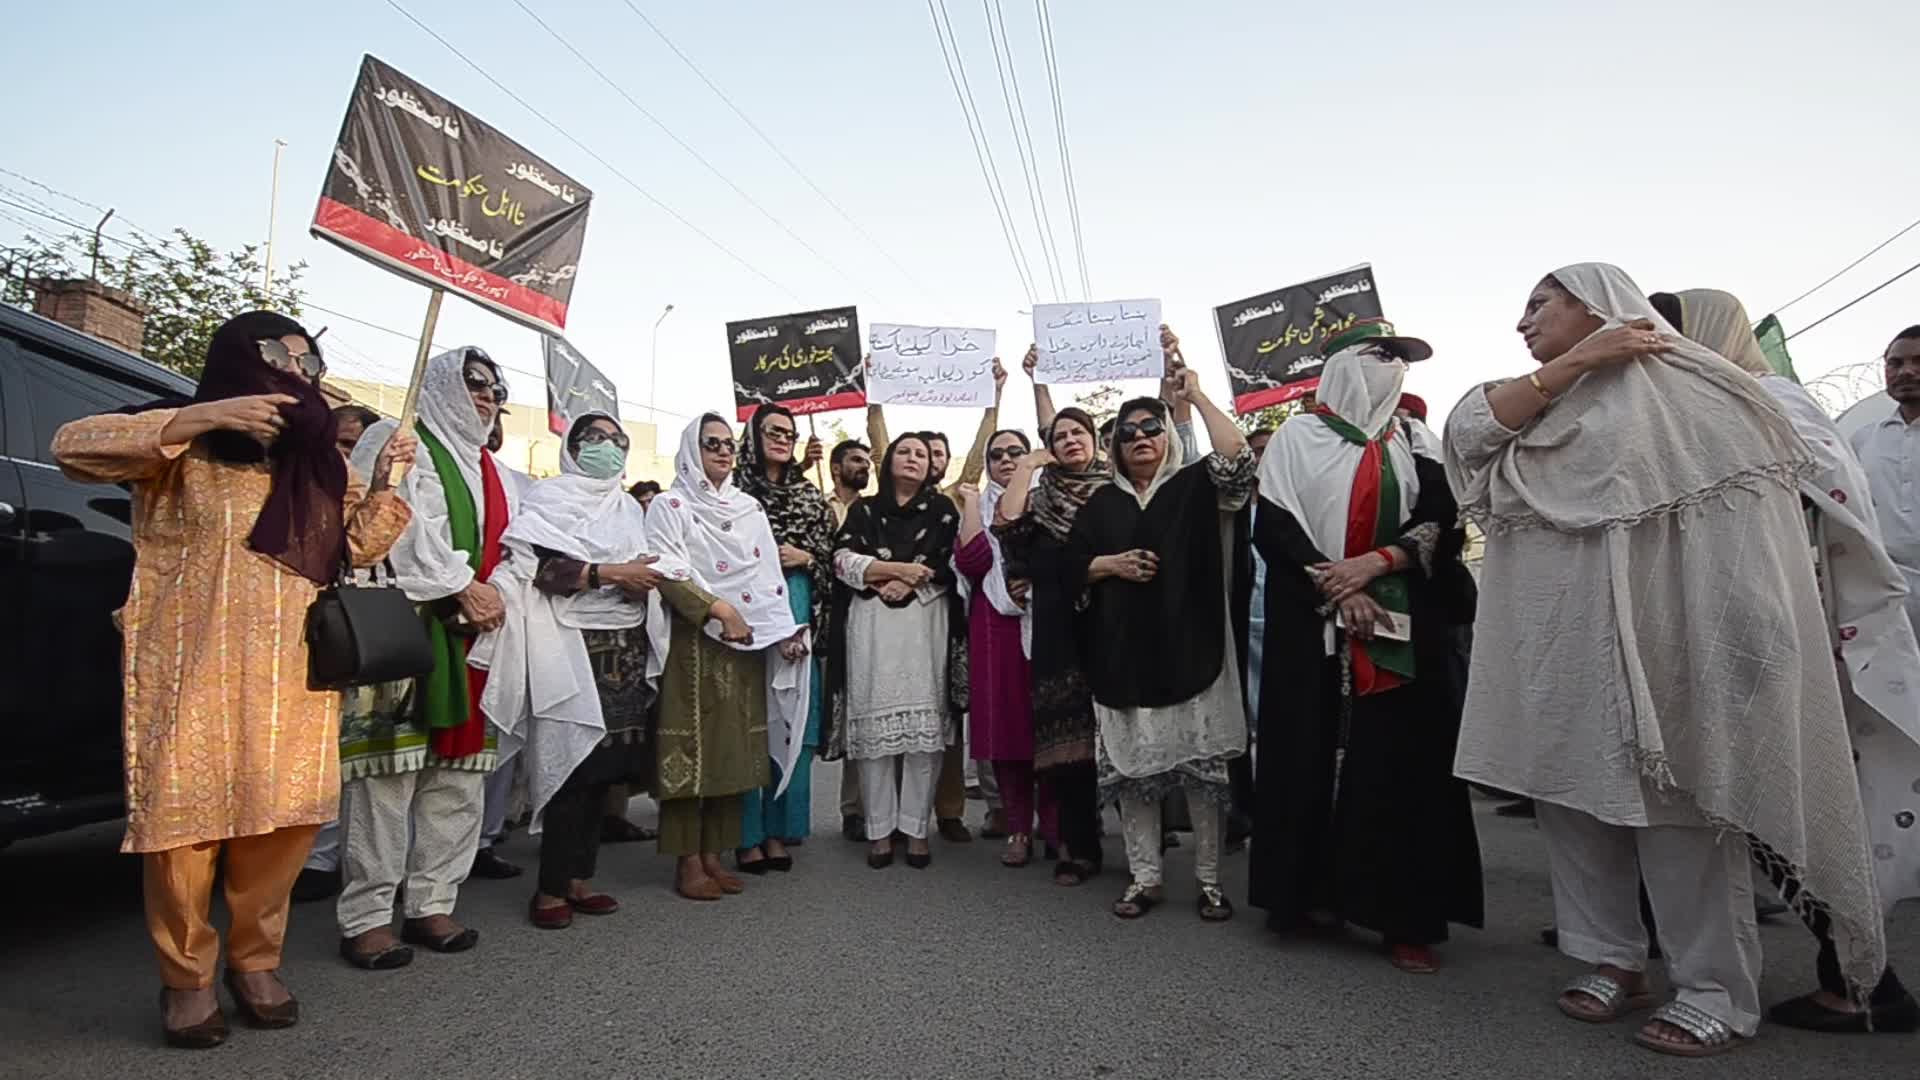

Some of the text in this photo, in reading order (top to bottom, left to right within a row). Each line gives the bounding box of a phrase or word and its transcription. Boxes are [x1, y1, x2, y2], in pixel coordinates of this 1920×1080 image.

[374, 86, 460, 140] نامنظور
[417, 163, 525, 227] نااہل حکومت
[505, 161, 576, 204] نامنظور
[424, 215, 504, 260] نامنظور
[1316, 279, 1372, 305] نامنظور
[804, 316, 848, 335] نامنظور
[1232, 300, 1285, 327] نامنظور
[1257, 307, 1357, 353] عوام دشمن حکومت
[735, 326, 778, 344] نامنظور
[776, 376, 820, 394] نامنظور
